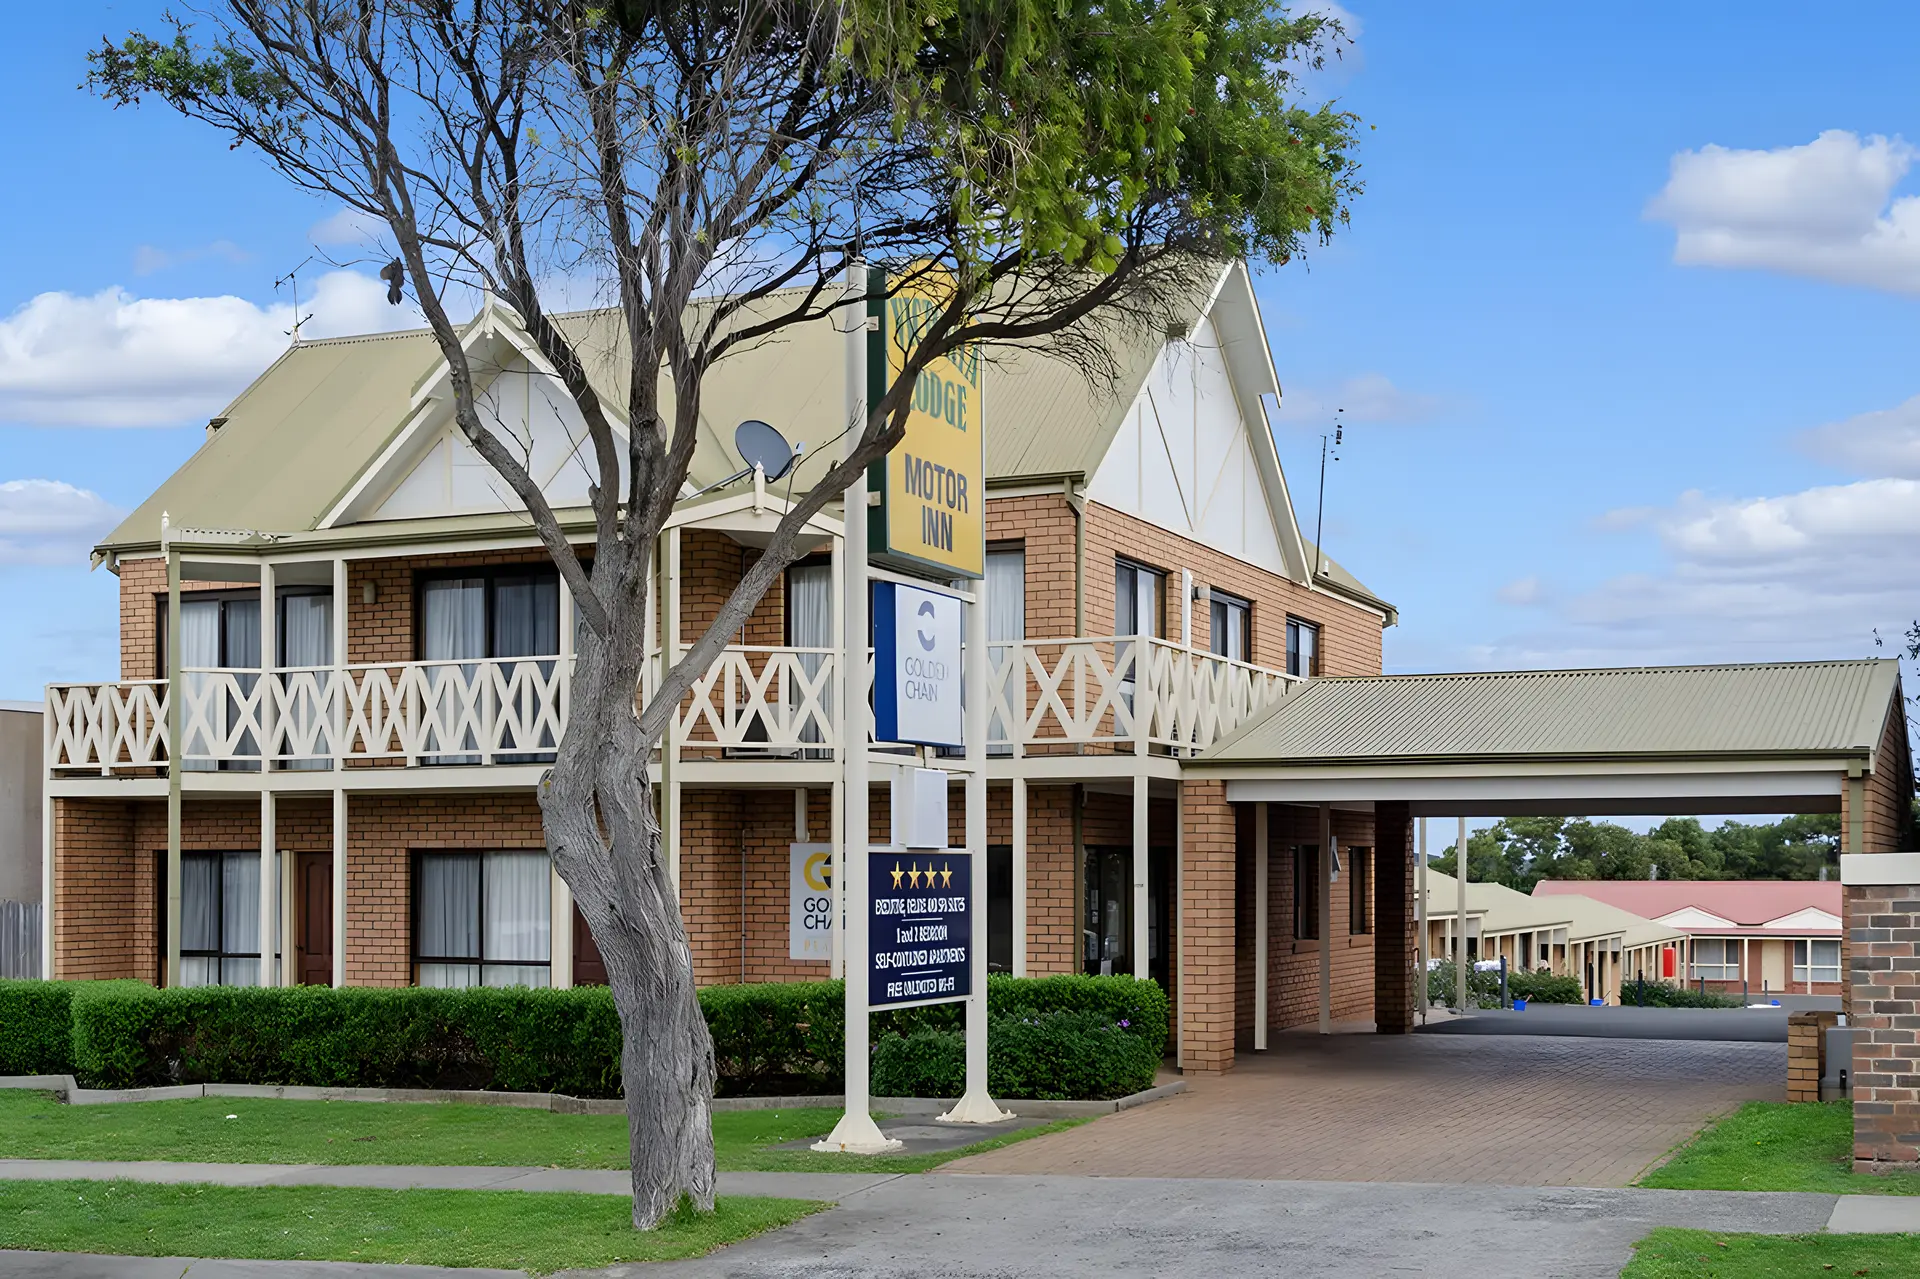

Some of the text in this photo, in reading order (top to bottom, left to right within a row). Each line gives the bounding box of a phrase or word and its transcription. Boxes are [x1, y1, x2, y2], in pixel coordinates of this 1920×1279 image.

[909, 368, 967, 433] ODGE
[904, 452, 969, 514] MOTOR
[922, 504, 953, 553] INN
